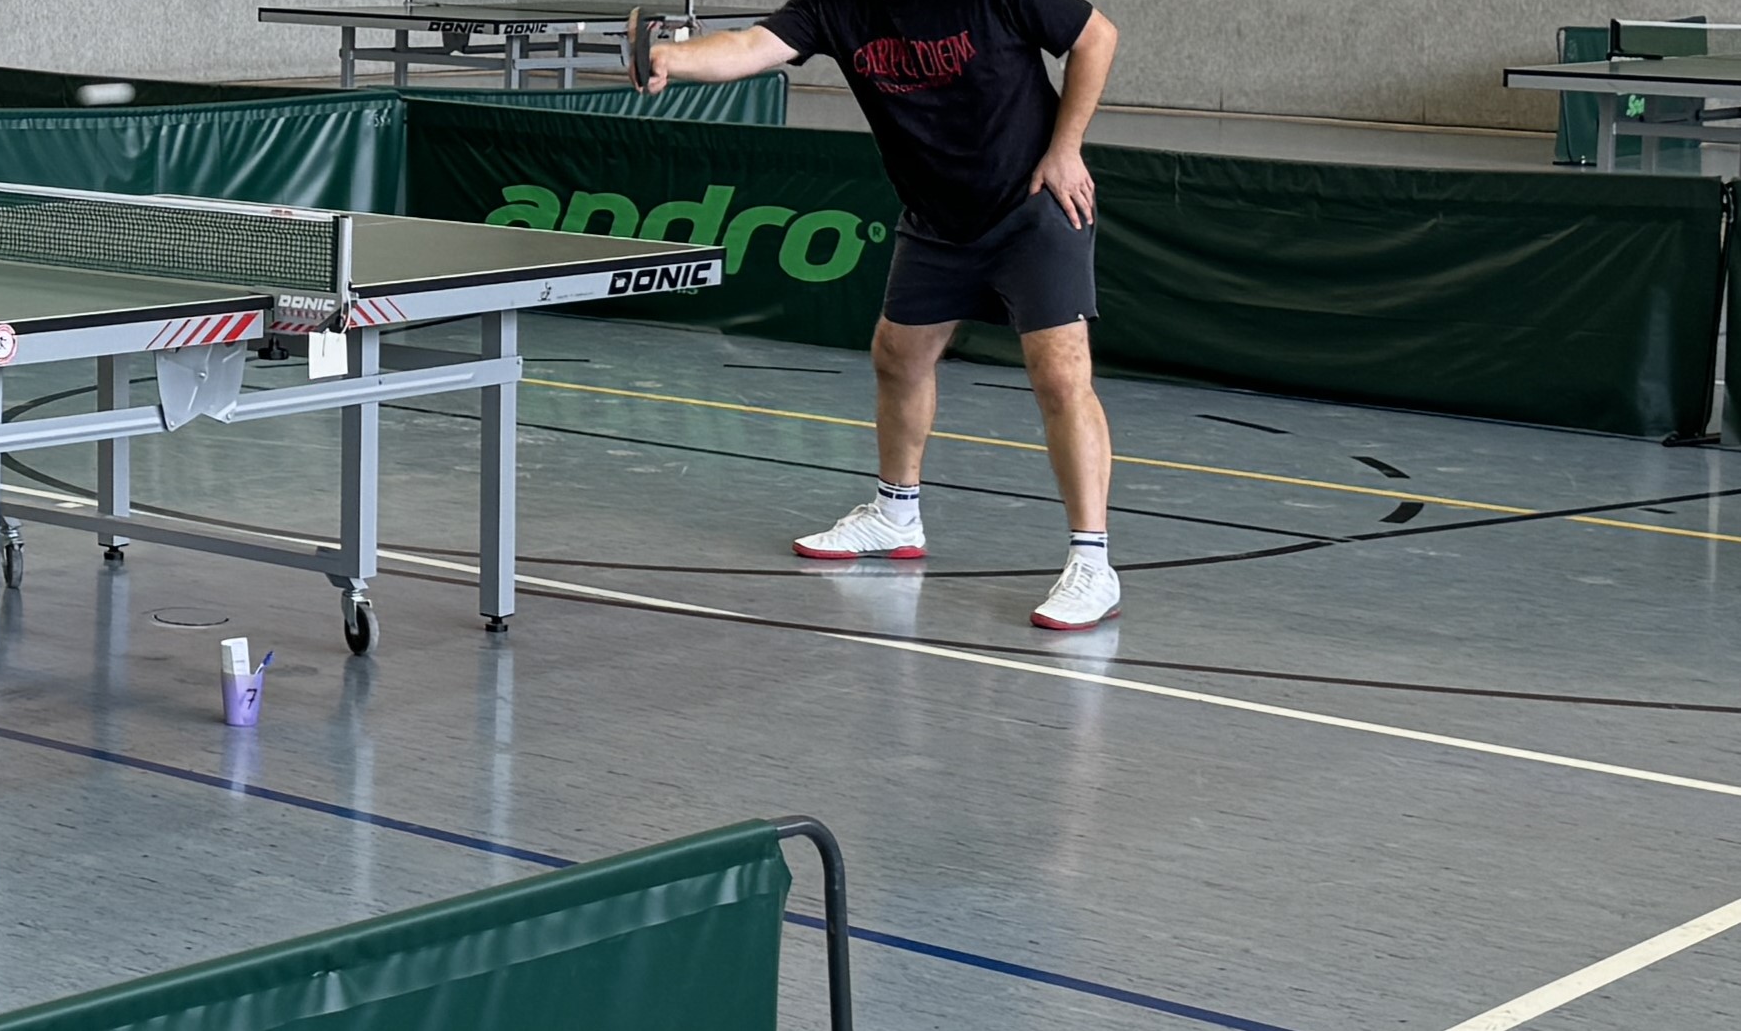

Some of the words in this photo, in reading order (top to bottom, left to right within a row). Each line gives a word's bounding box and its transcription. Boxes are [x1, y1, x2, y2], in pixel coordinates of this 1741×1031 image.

[427, 21, 485, 34] DONIC
[504, 23, 548, 35] DONIC
[607, 262, 712, 296] DONIC
[278, 294, 336, 312] DONIC
[246, 688, 258, 710] 7
